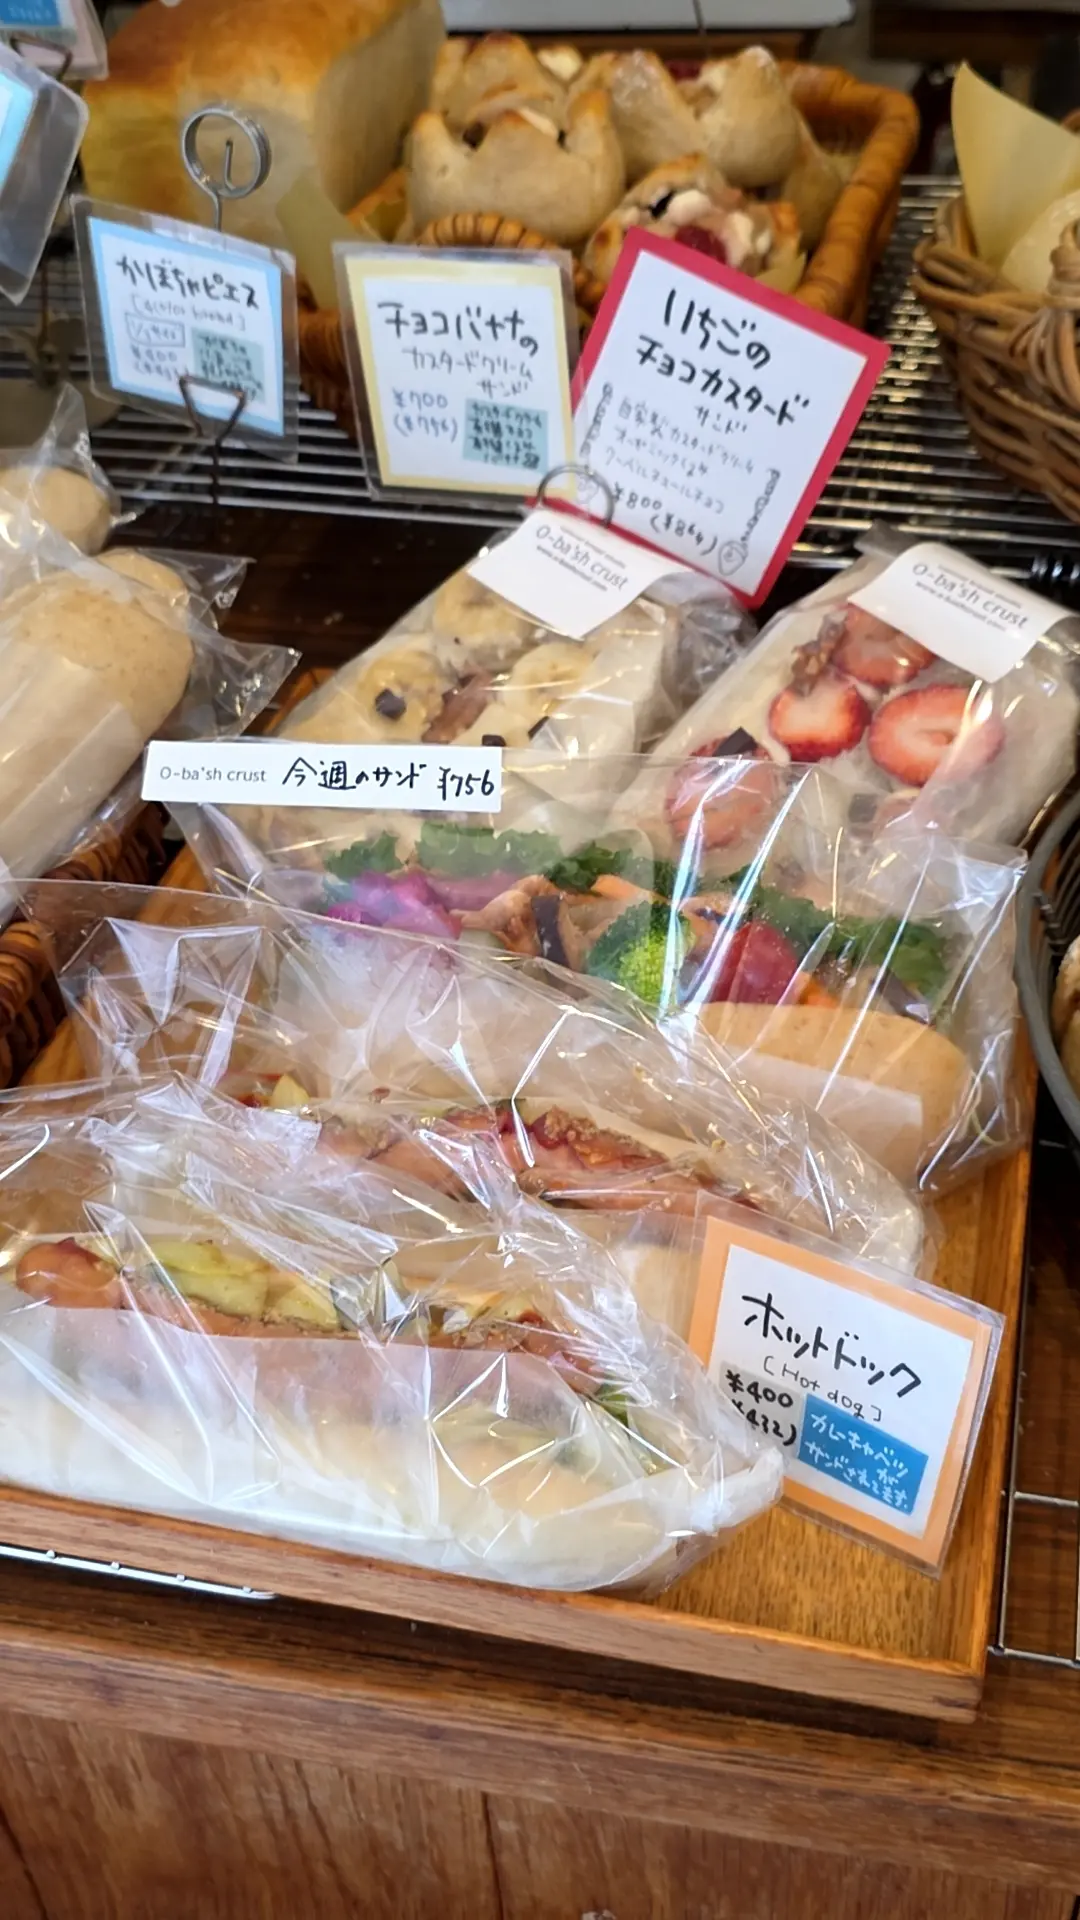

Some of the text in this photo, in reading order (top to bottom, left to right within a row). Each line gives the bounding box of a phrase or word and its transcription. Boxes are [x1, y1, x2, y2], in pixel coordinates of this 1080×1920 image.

[377, 301, 539, 357] チョコバナナの
[663, 289, 772, 370] いちごの
[401, 346, 533, 381] カスタードクリーム
[636, 334, 811, 427] チョコカスタード
[392, 387, 449, 411] ¥700
[476, 379, 529, 399] サンド
[694, 405, 748, 435] サンド
[612, 482, 663, 511] ¥800
[649, 510, 719, 557] (¥864)
[591, 561, 629, 590] crust
[983, 597, 1029, 629] crust
[159, 756, 495, 801] O-ba'sh crust 今週のサンド ¥756
[742, 1293, 922, 1398] ホットドック
[725, 1369, 794, 1408] ¥400
[810, 1412, 909, 1478] カレーキャベツ
